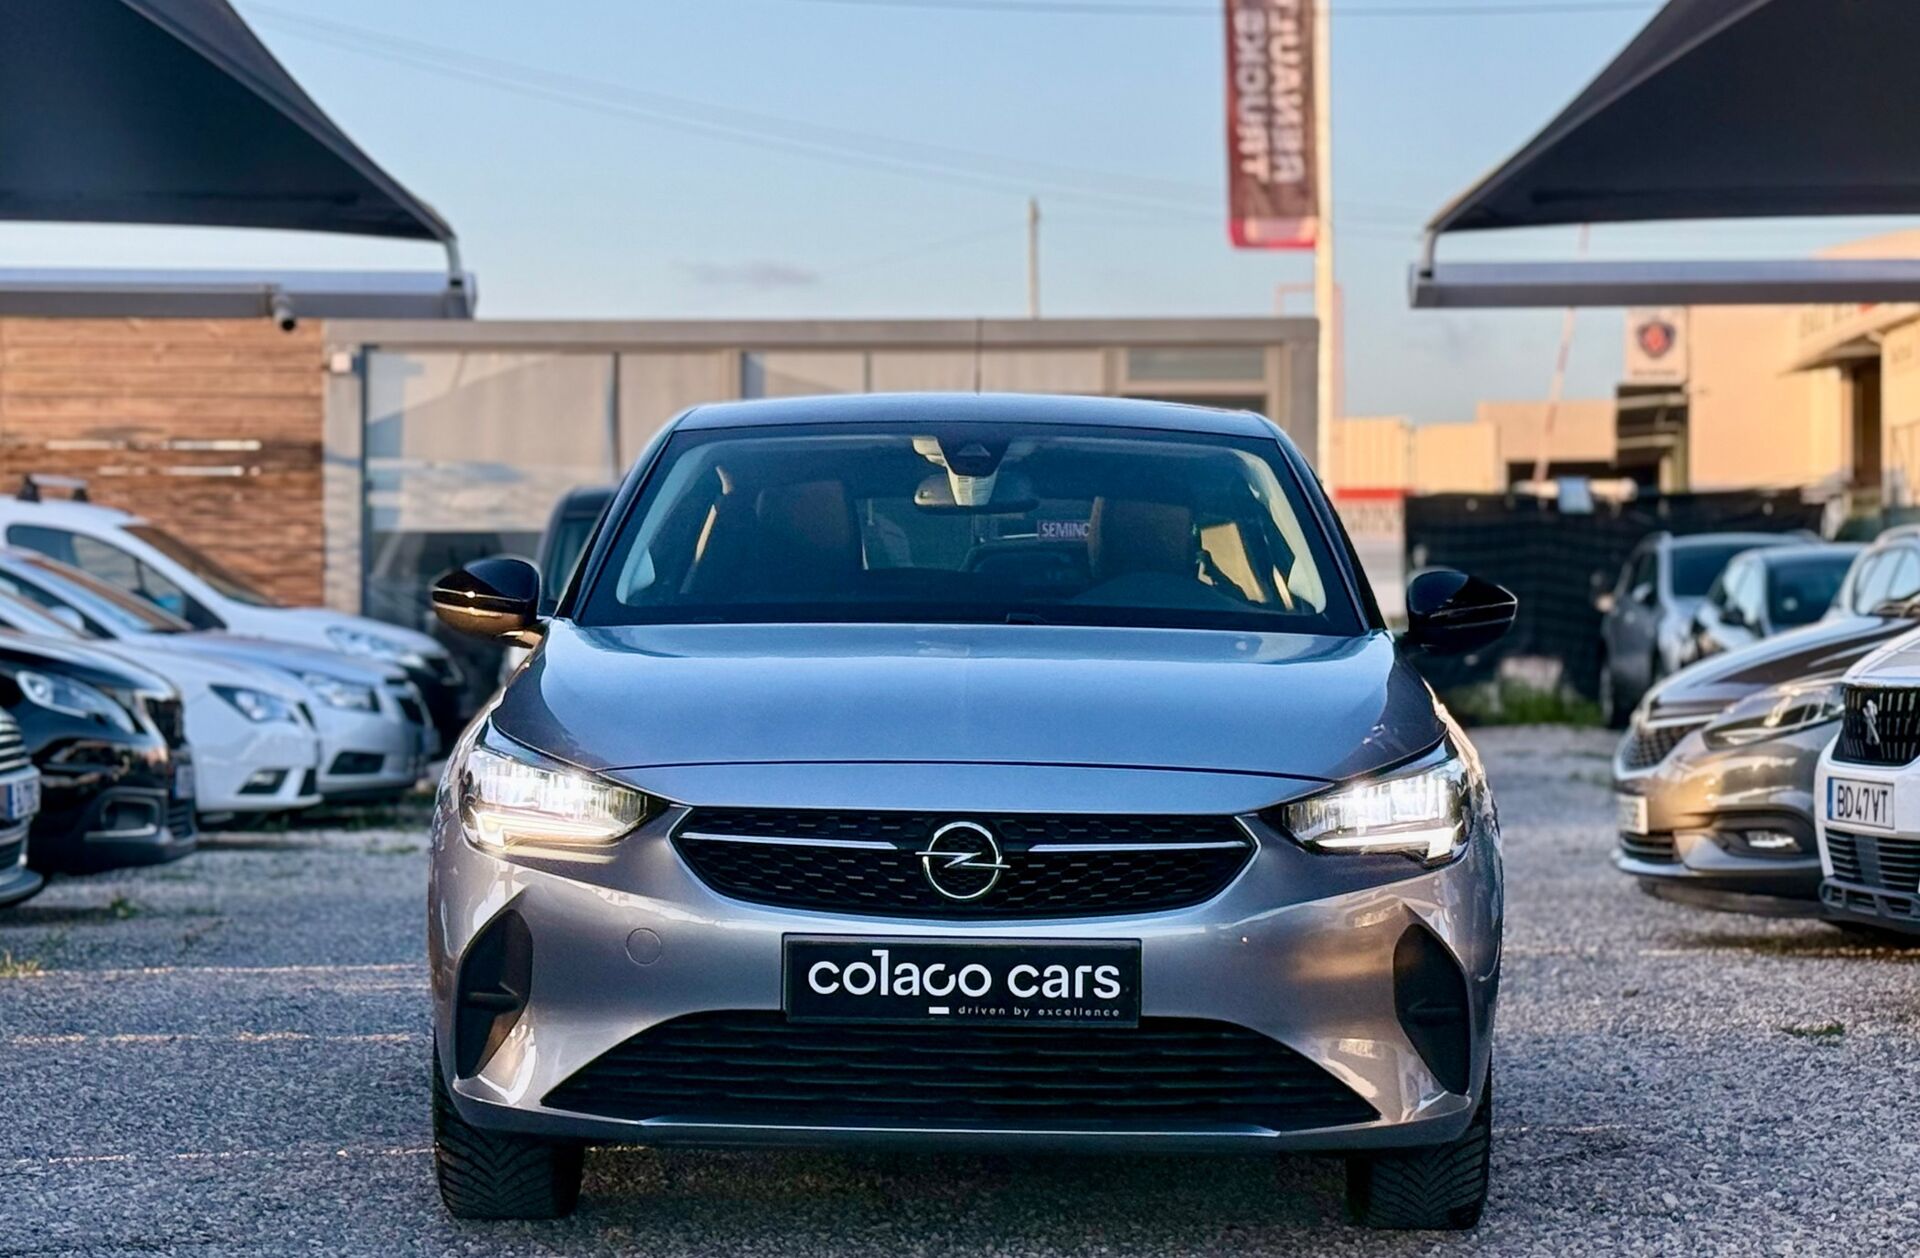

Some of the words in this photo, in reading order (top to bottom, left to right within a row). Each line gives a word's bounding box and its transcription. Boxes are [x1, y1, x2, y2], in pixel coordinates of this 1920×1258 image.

[1007, 963, 1121, 999] cars
[958, 1005, 1006, 1015] driven
[1014, 1006, 1030, 1018] by
[1037, 1006, 1120, 1017] excellence
